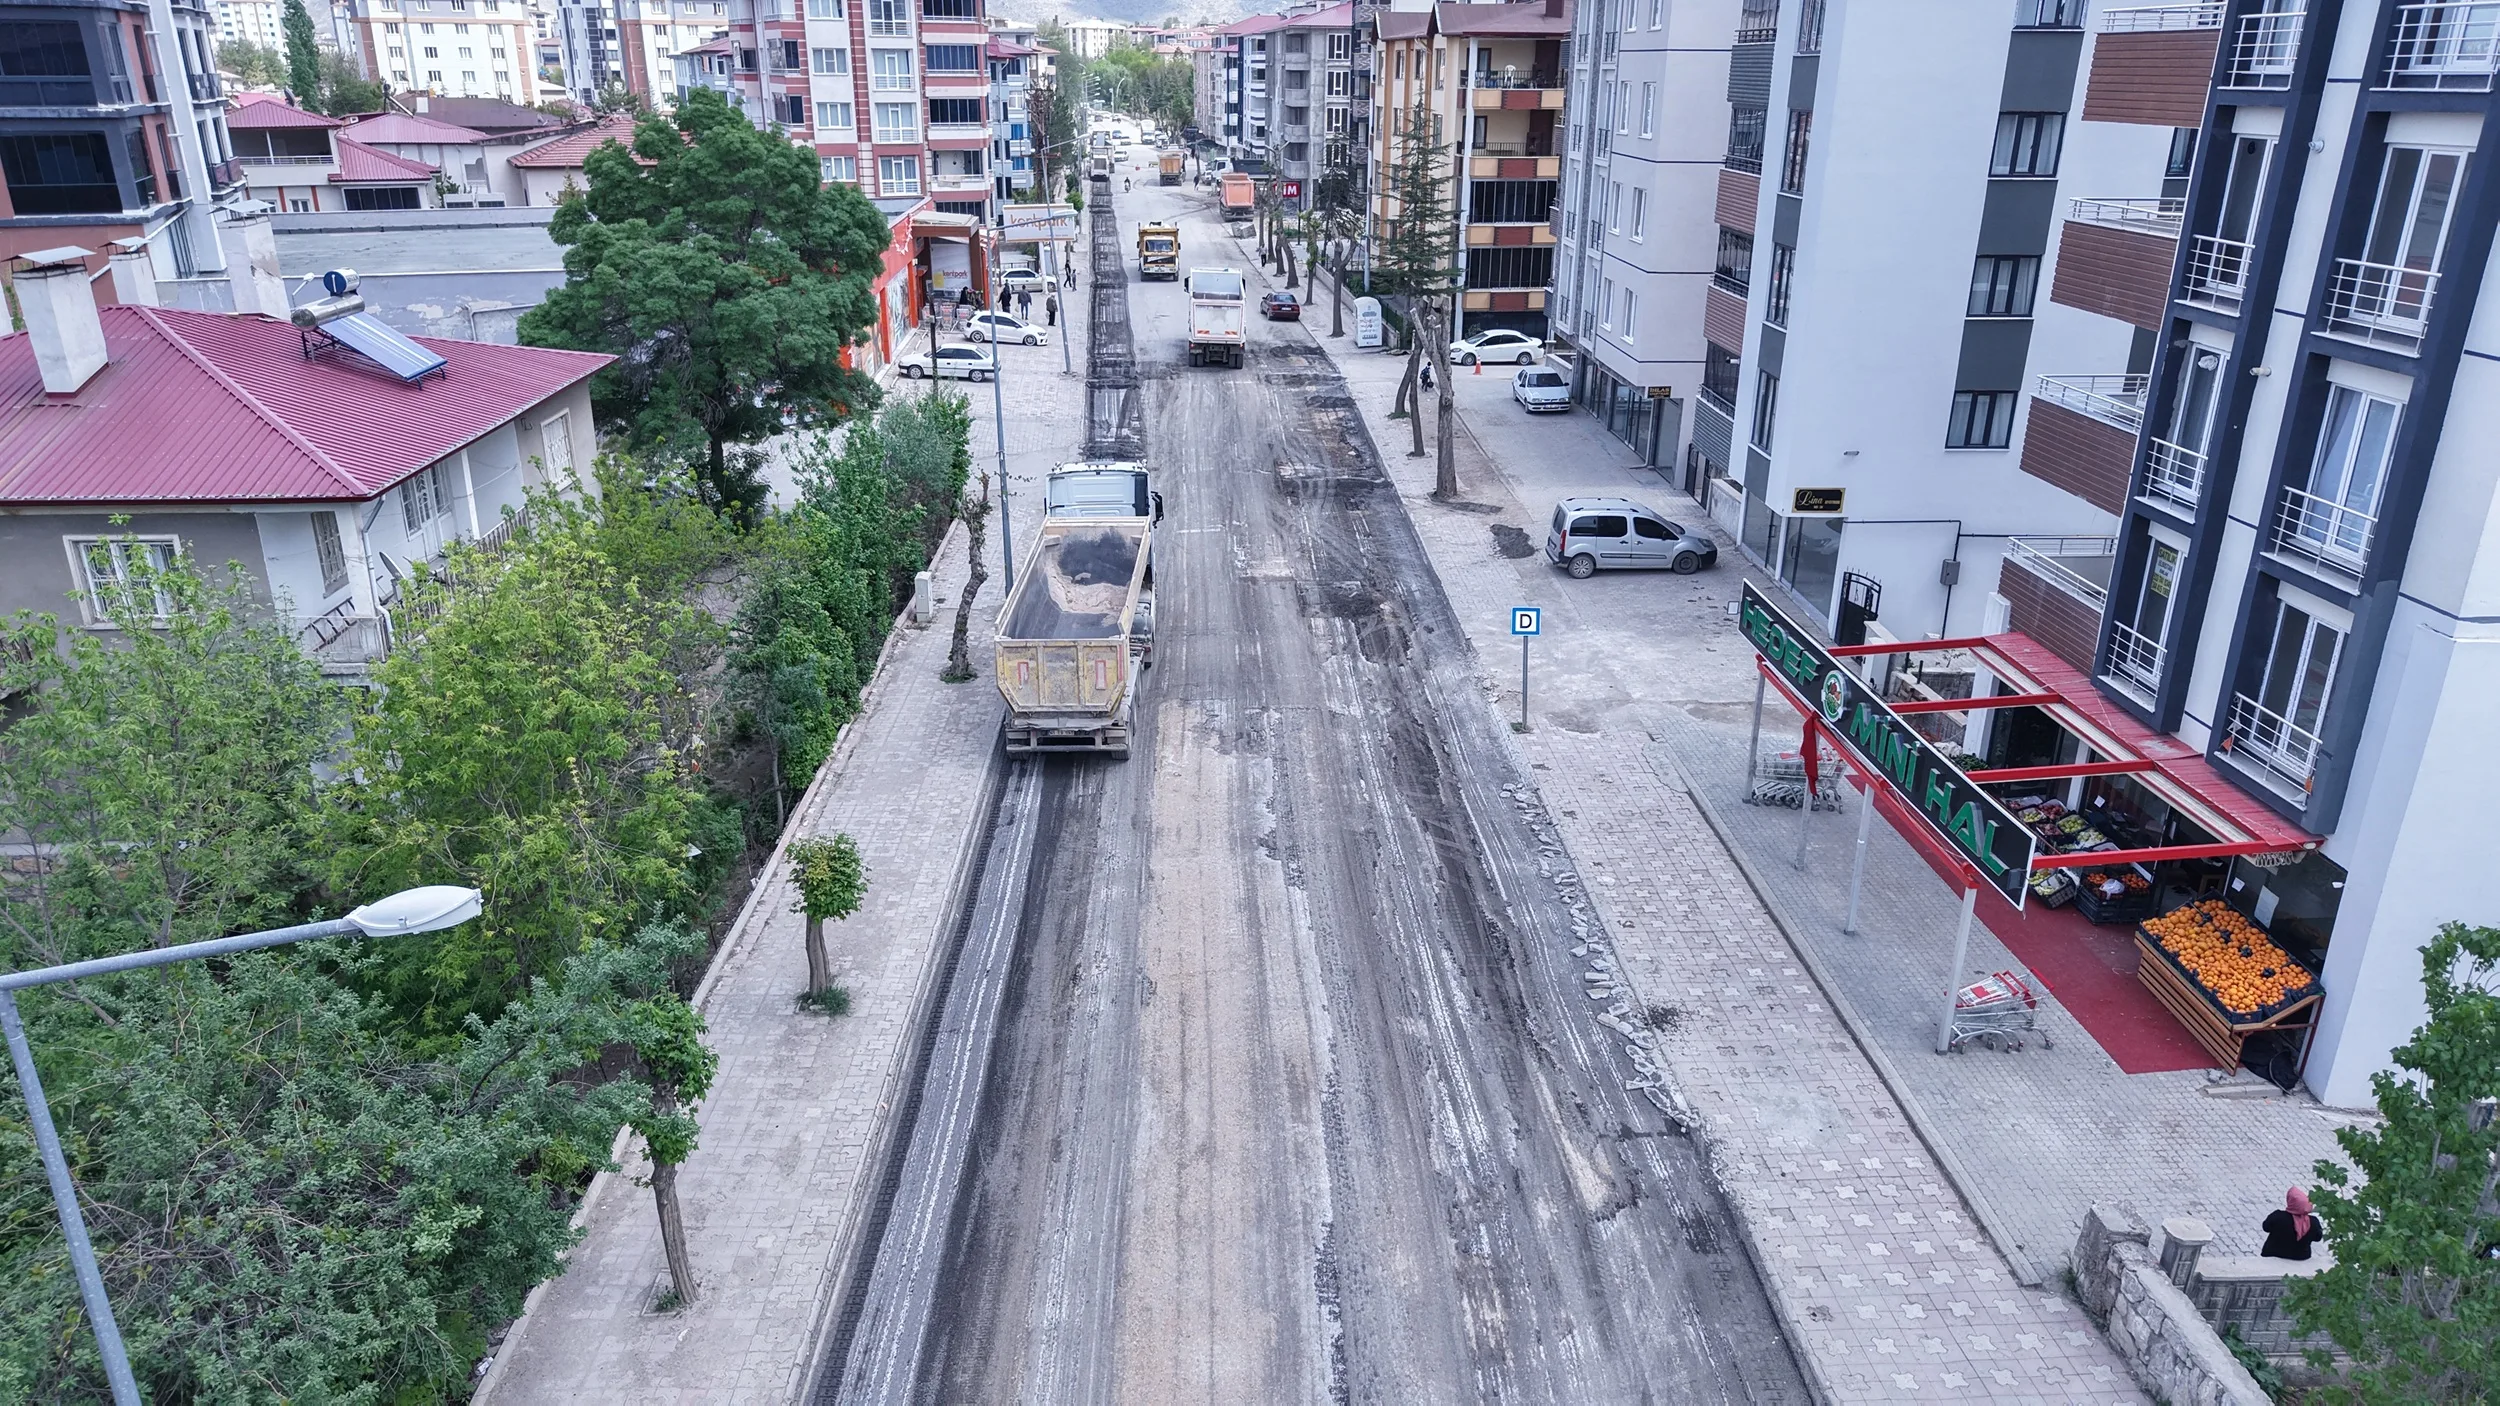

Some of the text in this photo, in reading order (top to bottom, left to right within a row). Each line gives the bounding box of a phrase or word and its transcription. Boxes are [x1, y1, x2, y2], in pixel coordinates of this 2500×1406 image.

[1274, 182, 1297, 196] İM
[1797, 490, 1823, 506] Lina
[1519, 613, 1532, 629] D
[1743, 597, 2009, 876] HEDEF MİNİ HAL
